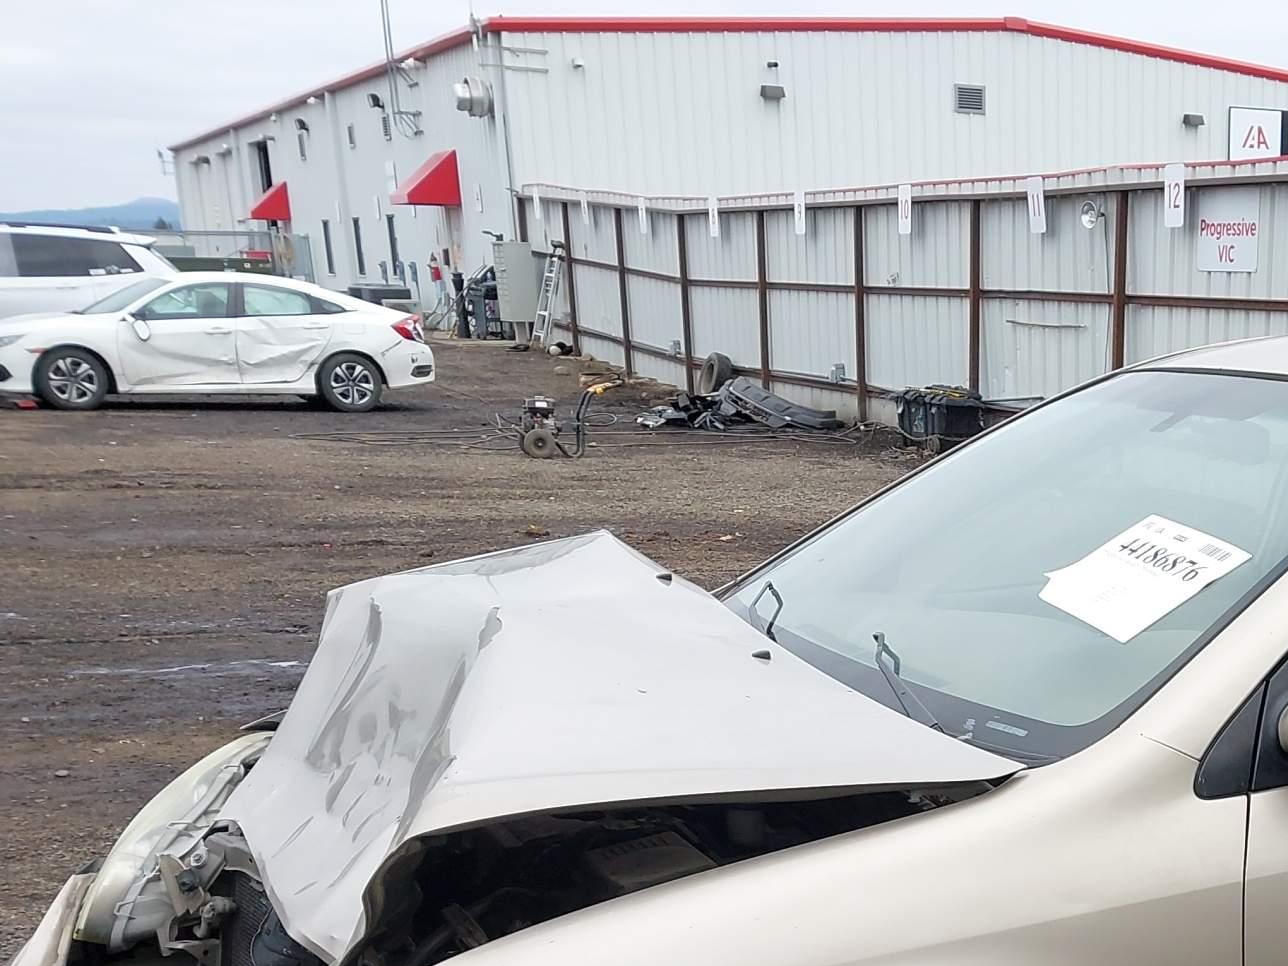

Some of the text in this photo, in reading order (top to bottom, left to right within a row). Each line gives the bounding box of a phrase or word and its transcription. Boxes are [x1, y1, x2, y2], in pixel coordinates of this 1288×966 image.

[1032, 193, 1041, 217] 11
[1168, 182, 1180, 208] 12
[900, 199, 909, 220] 10
[1200, 217, 1257, 240] Progressive
[1218, 244, 1235, 263] VIC
[1118, 538, 1208, 582] 44186876
